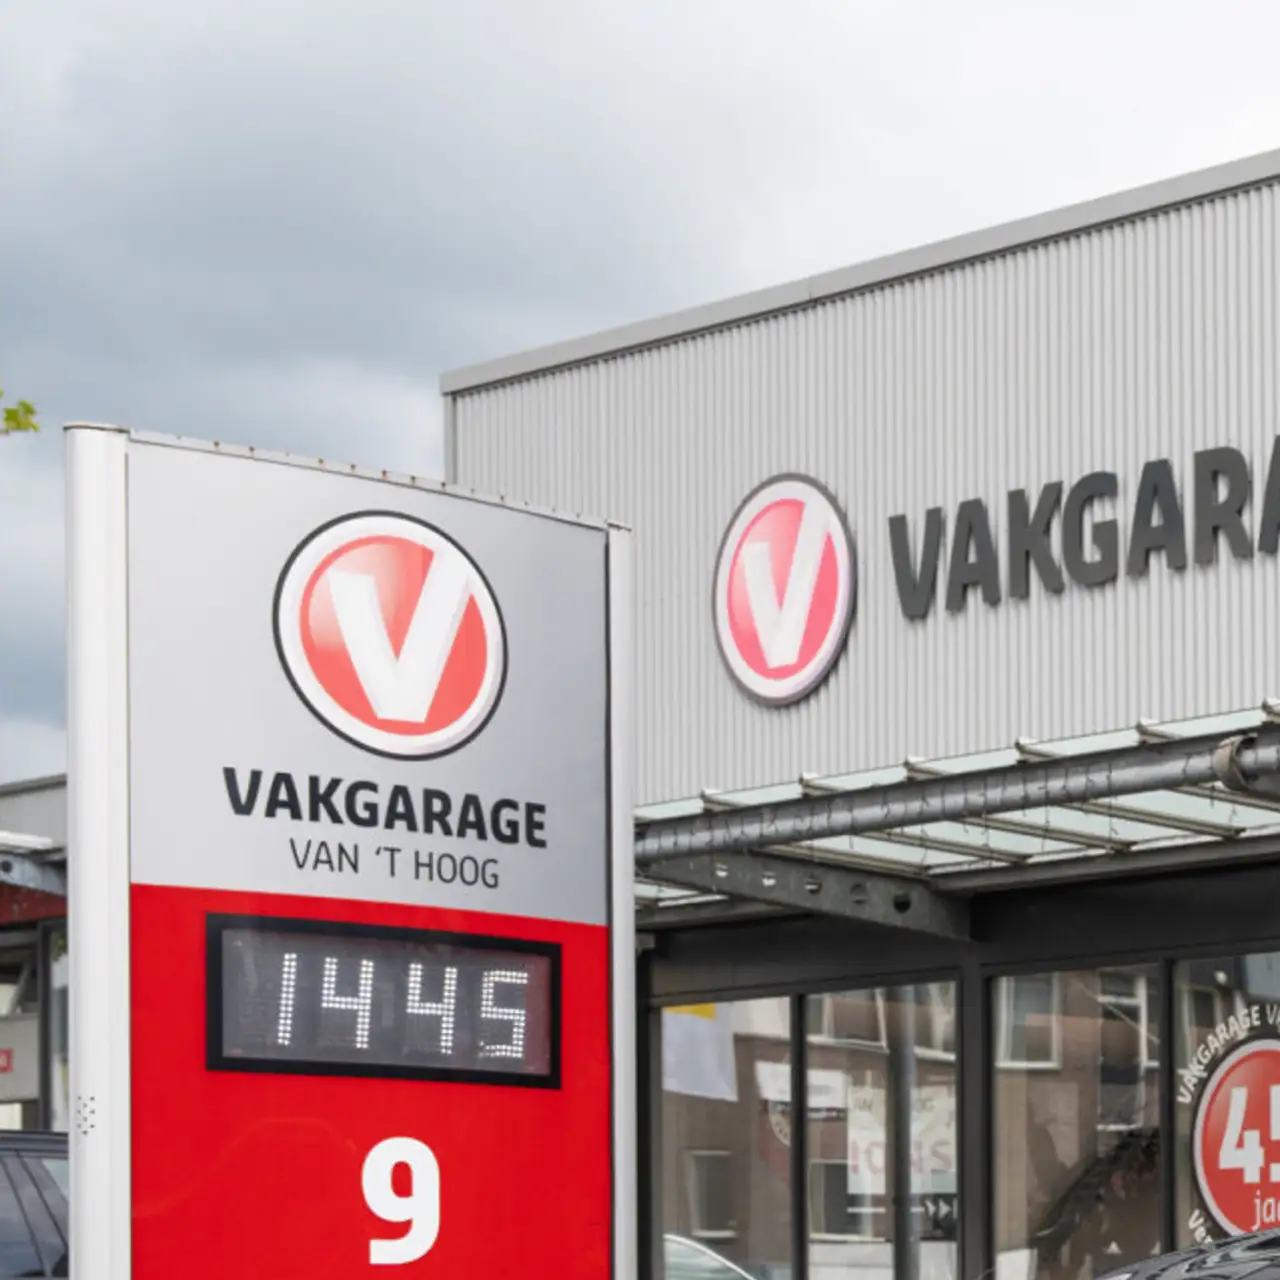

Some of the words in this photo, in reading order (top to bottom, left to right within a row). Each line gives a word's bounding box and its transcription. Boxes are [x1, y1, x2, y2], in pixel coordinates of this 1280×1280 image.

[223, 766, 547, 849] VAKGARAGE
[289, 838, 359, 874] VAN
[414, 850, 499, 889] HOOG
[1177, 1004, 1261, 1104] VAKGARAGE
[362, 1137, 440, 1264] 9
